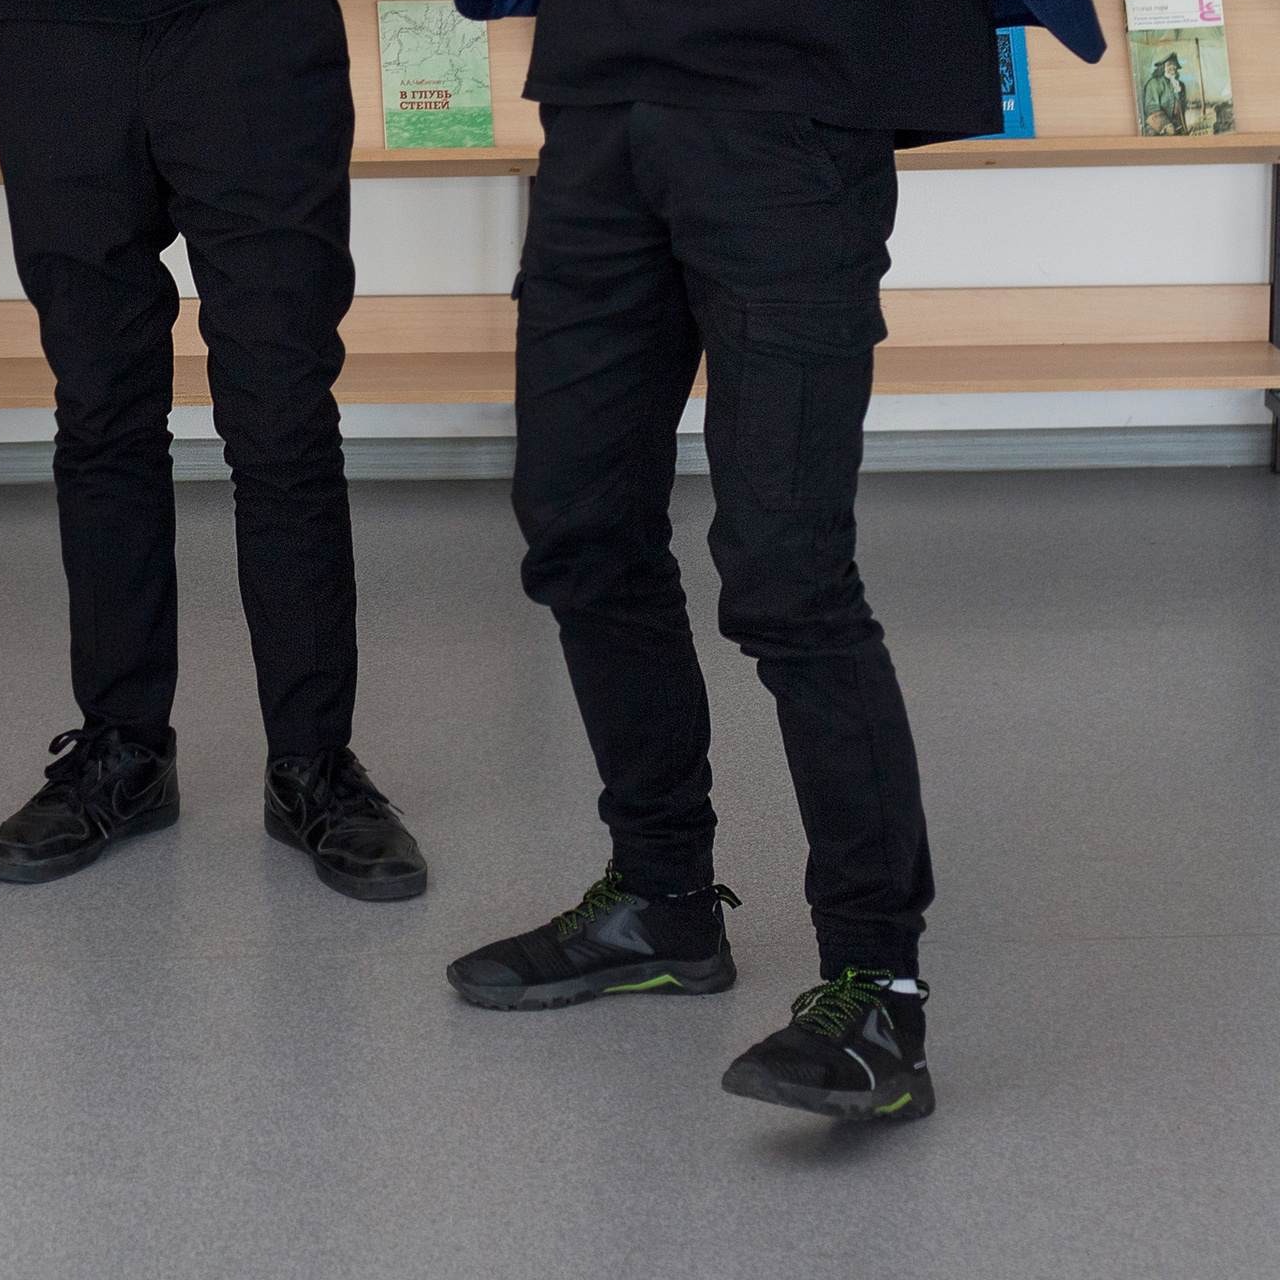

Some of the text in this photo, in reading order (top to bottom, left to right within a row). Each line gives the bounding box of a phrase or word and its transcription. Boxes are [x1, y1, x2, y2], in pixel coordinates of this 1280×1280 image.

[400, 90, 452, 99] В ГЛУБЬ
[400, 99, 450, 110] СТЕПЕЙ
